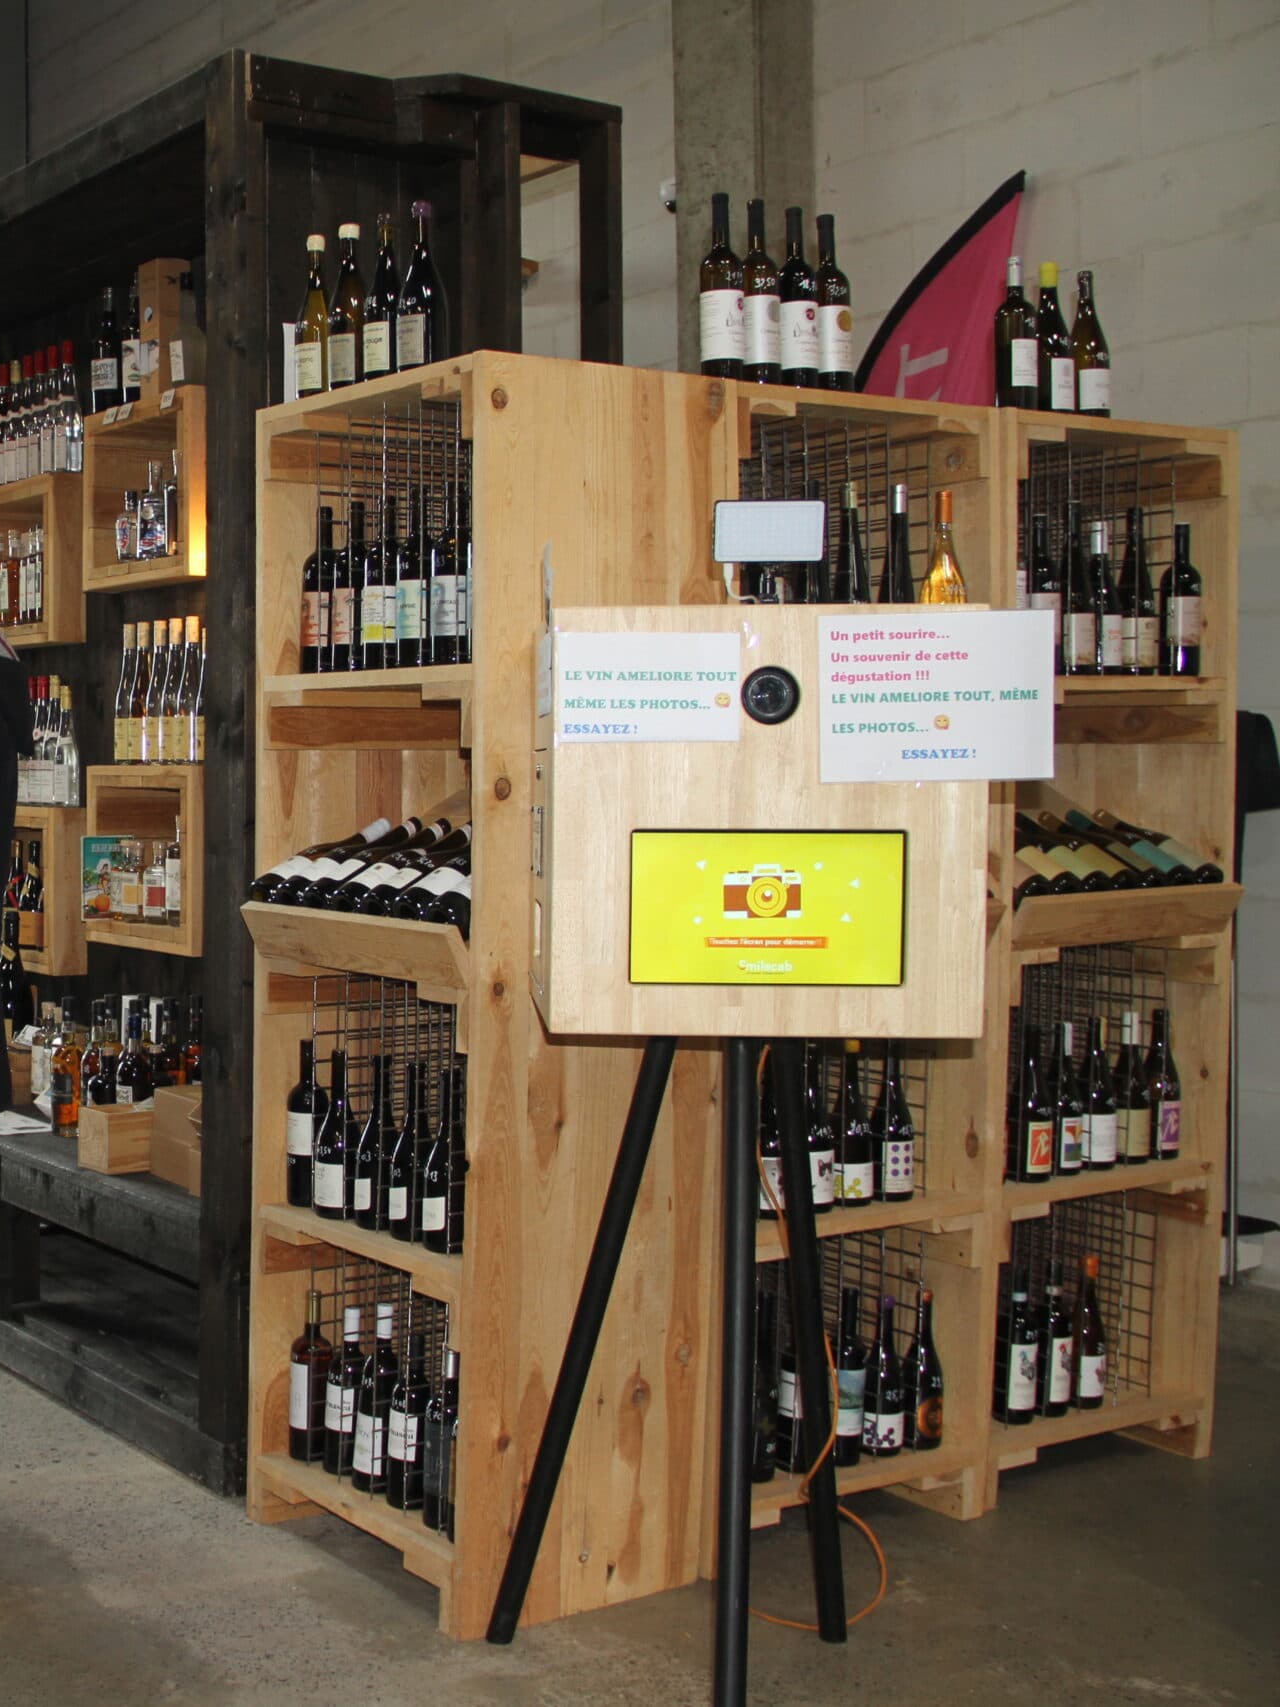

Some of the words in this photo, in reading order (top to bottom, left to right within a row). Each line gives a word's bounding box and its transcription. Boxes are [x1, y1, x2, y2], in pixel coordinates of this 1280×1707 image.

[830, 631, 849, 641] Un
[853, 630, 885, 643] petit
[888, 629, 951, 641] sourire...
[831, 652, 849, 663] Un
[853, 651, 911, 662] souvenir
[914, 650, 932, 661] de
[935, 650, 969, 661] cette
[564, 671, 583, 681] LE
[586, 671, 613, 681] VIN
[616, 671, 693, 681] AMELIORE
[696, 671, 737, 681] TOUT
[831, 672, 912, 685] dégustation
[831, 693, 847, 704] LE
[850, 692, 876, 703] VIN
[879, 691, 950, 703] AMELIORE
[954, 690, 995, 702] TOUT,
[999, 687, 1039, 701] MÊME
[564, 697, 606, 709] MÊME
[610, 699, 637, 709] LES
[640, 699, 711, 710] PHOTOS...
[564, 723, 631, 735] ESSAYEZ
[832, 723, 855, 734] LES
[858, 721, 929, 733] PHOTOS...
[901, 748, 970, 760] ESSAYEZ
